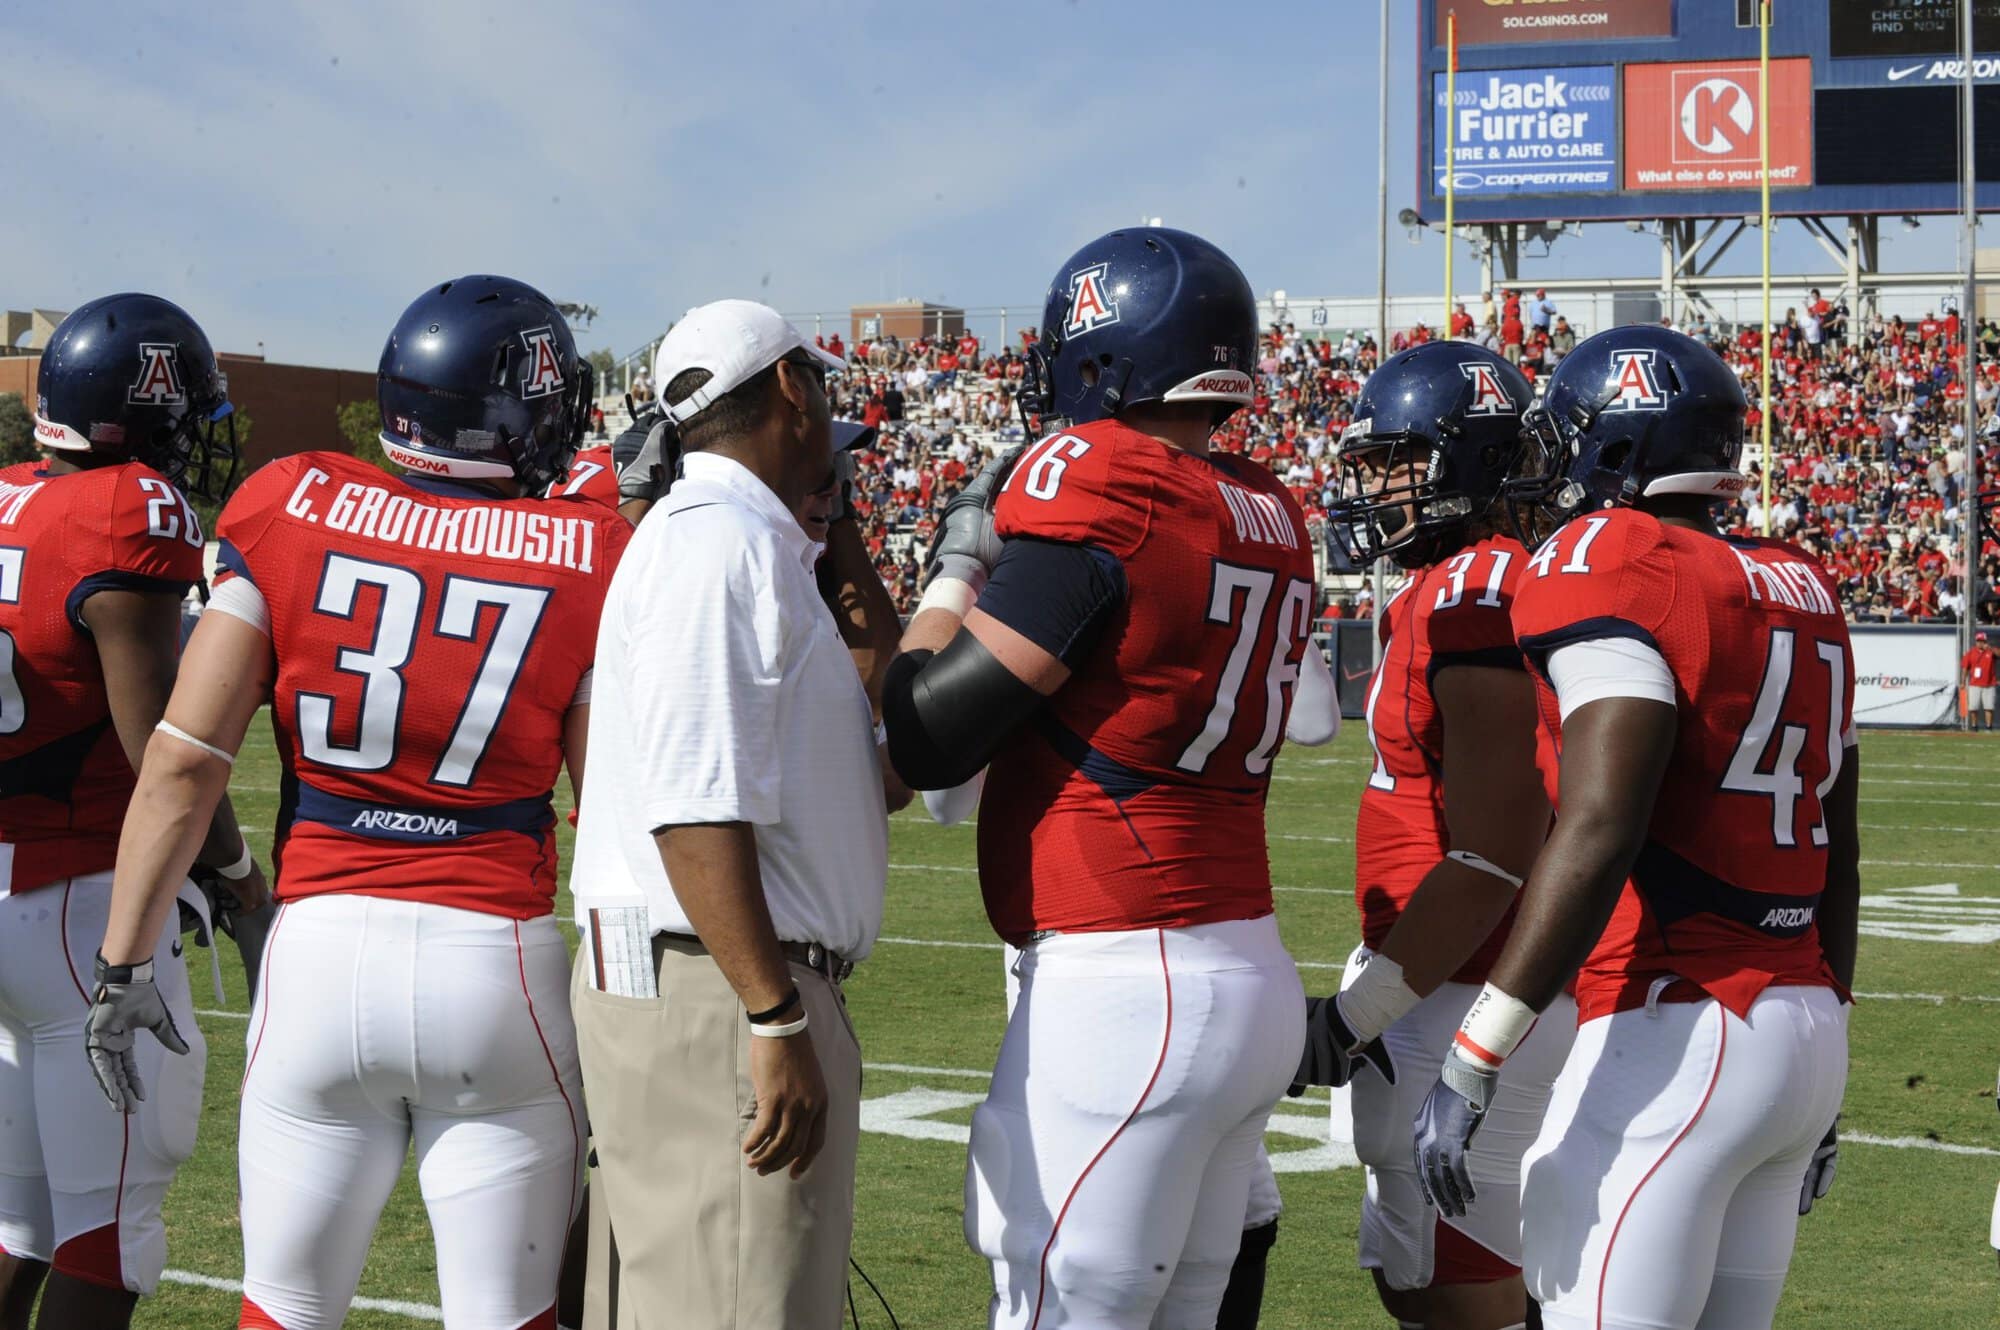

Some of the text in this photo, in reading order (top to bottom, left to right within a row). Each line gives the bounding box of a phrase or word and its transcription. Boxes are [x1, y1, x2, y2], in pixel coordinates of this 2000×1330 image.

[1503, 13, 1608, 28] SOLCASINOS.COM
[1872, 8, 1955, 20] CHECKING
[1872, 22, 1904, 32] AND
[1480, 75, 1568, 110] Jack
[1459, 109, 1589, 142] Furrier
[1488, 146, 1501, 160] &
[1506, 144, 1552, 159] AUTO
[1558, 143, 1604, 157] CARE
[1637, 168, 1673, 184] What
[1675, 168, 1705, 182] else
[1707, 167, 1725, 182] do
[1727, 169, 1753, 184] you
[1063, 263, 1120, 341] A
[1313, 310, 1326, 324] 27
[519, 327, 567, 401] A
[1213, 345, 1228, 363] 76
[128, 342, 187, 406] A
[1192, 378, 1251, 394] ARIZONA
[1458, 361, 1518, 418] A
[1599, 348, 1668, 415] A
[395, 416, 409, 434] 37
[388, 449, 451, 475] ARIZONA
[285, 467, 596, 574] C. GRONKOWSKI
[1216, 480, 1299, 551] QUINN
[1526, 516, 1610, 579] 41
[1434, 550, 1513, 612] 31
[295, 549, 556, 789] 37
[1175, 557, 1313, 776] 76
[1854, 672, 1910, 689] verizon
[1719, 626, 1846, 850] 41
[351, 810, 459, 837] ARIZONA
